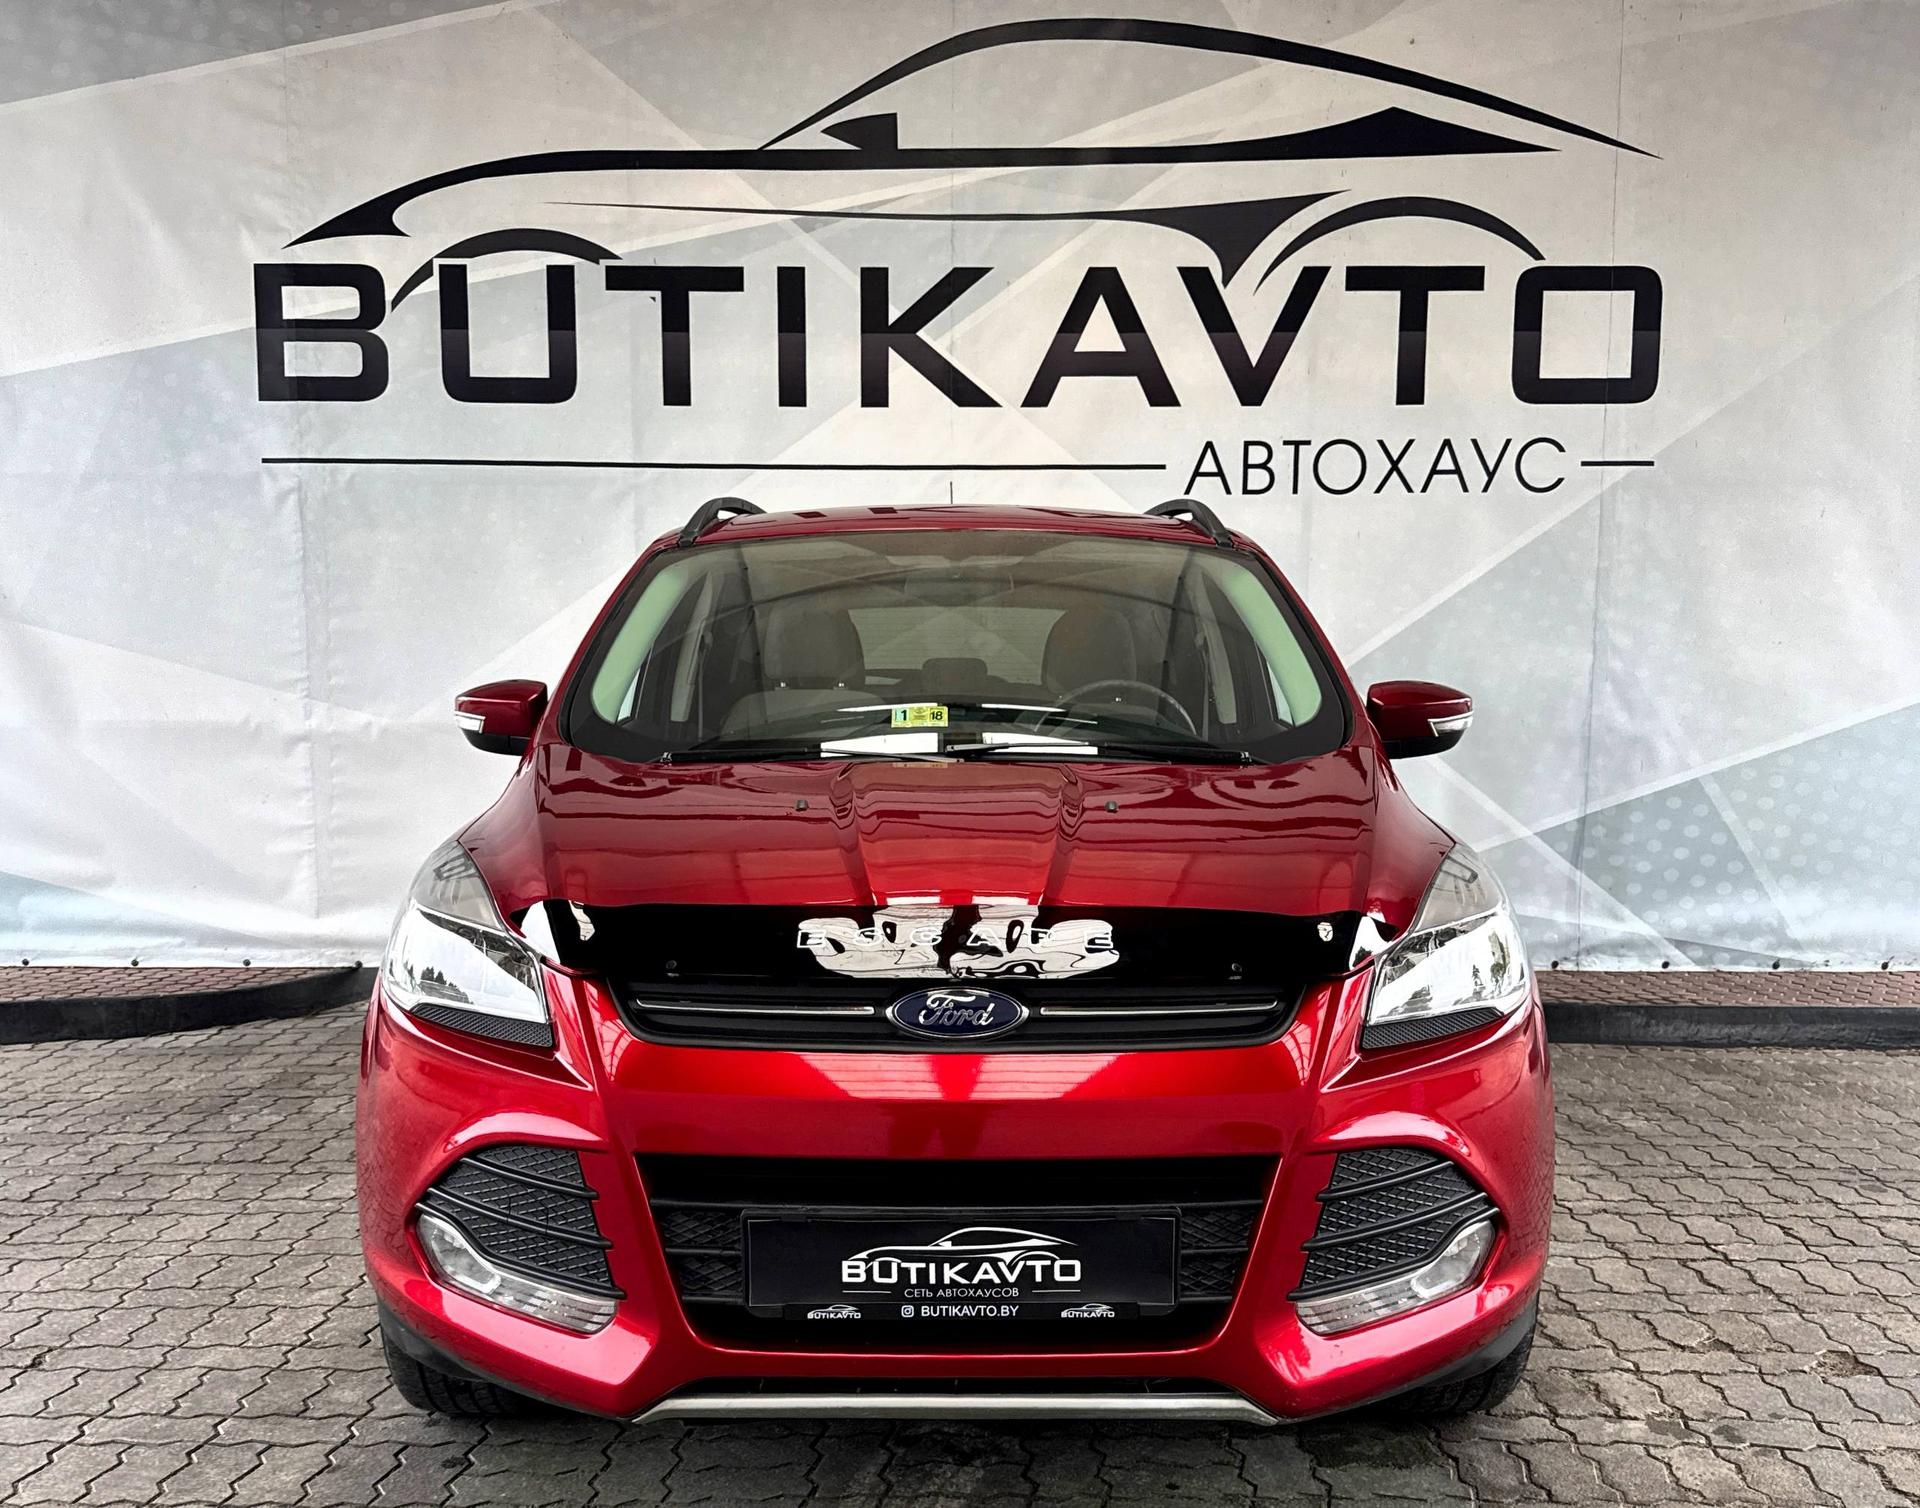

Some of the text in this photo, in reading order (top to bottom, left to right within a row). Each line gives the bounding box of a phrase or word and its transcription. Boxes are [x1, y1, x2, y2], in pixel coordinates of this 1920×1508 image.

[253, 263, 1664, 408] BUTIKAVTO
[1183, 437, 1567, 496] АВТОХАУС
[901, 709, 907, 721] 1
[930, 710, 943, 721] 18
[797, 928, 1114, 949] ESCAPE
[918, 993, 995, 1026] Ford
[841, 1259, 1082, 1285] BUTIKAVTO
[904, 1286, 1020, 1298] СЕТЬ АВТОХАУСОВ
[807, 1311, 862, 1319] BUTIKAVTO
[921, 1305, 1019, 1317] BUTIKAVTO.BY
[1061, 1310, 1115, 1318] BUTIKAVTO
